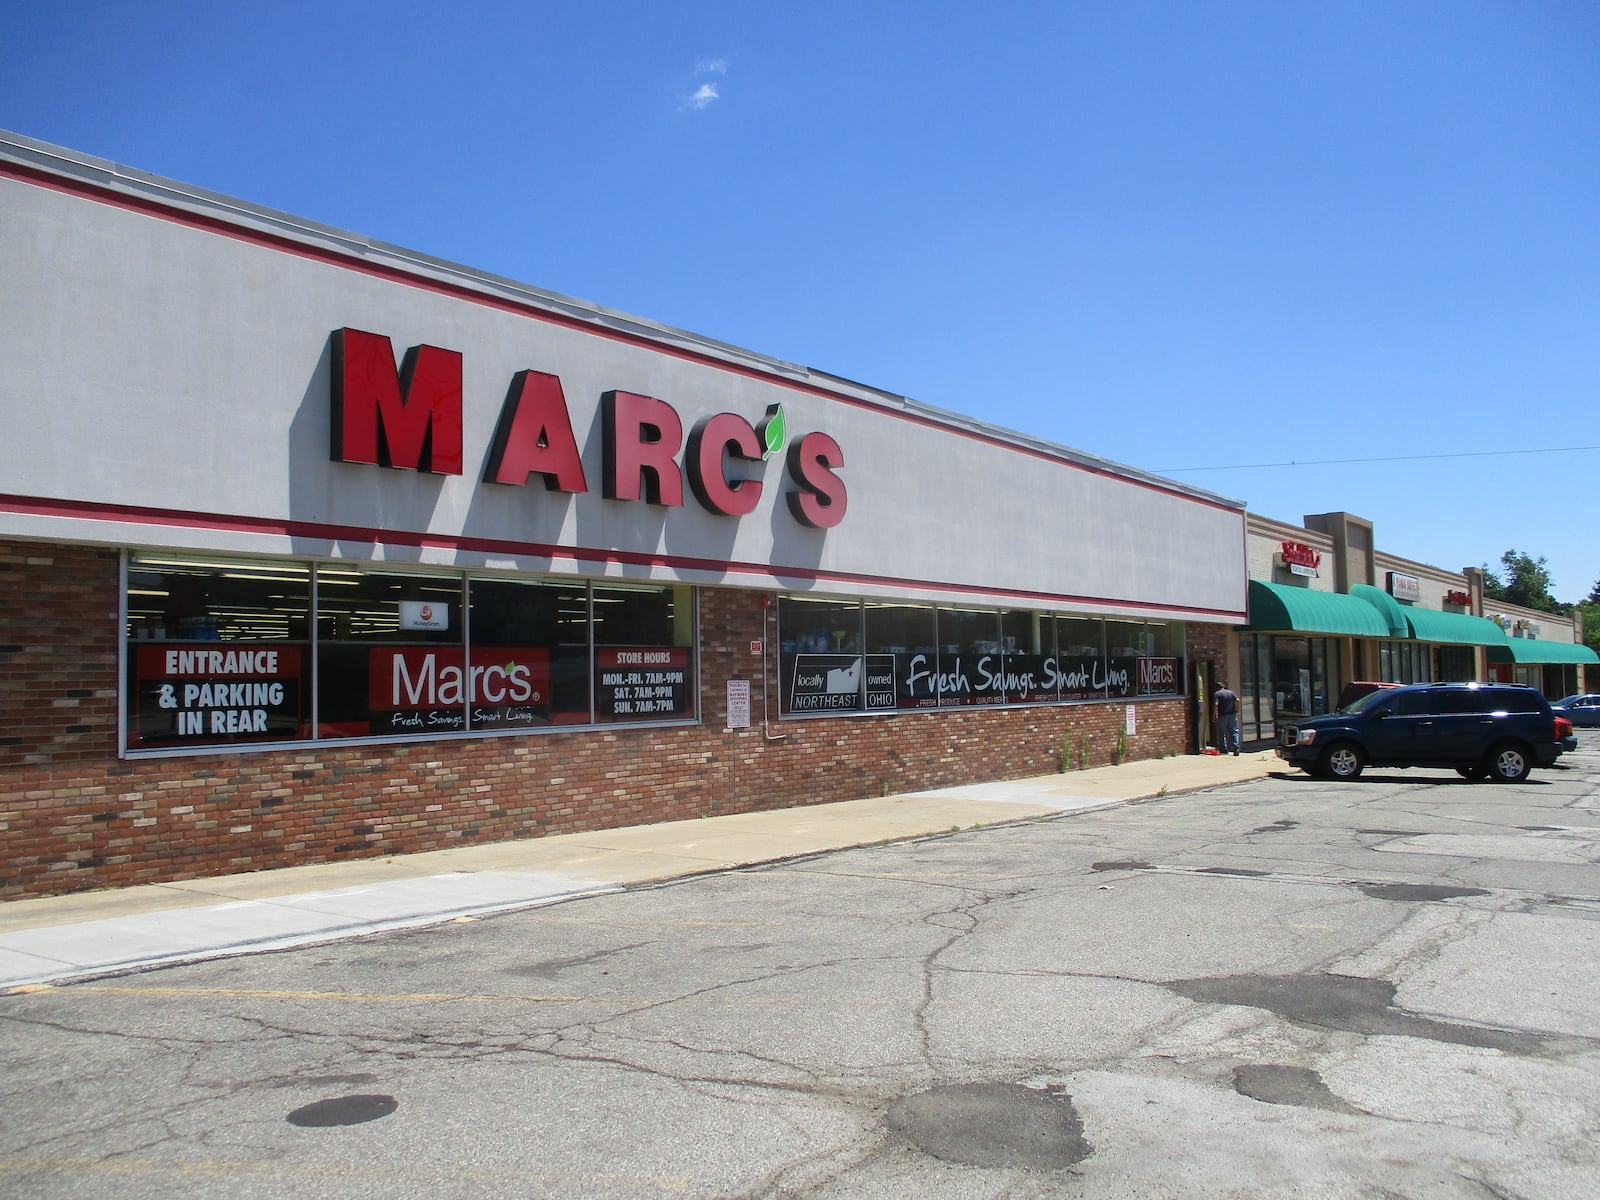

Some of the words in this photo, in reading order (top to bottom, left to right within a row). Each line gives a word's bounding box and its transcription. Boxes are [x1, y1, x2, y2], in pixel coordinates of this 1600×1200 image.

[331, 326, 848, 529] MARC'S
[165, 650, 278, 675] ENTRANCE
[616, 651, 643, 664] STORE
[643, 651, 671, 664] HOURS
[392, 653, 532, 706] Marc's
[602, 672, 644, 686] MON.-FRI.
[645, 671, 683, 684] 7AM-9PM
[798, 673, 825, 688] locally
[868, 673, 892, 685] owned
[905, 654, 971, 697] Fresh
[1041, 657, 1090, 691] Smart
[158, 684, 178, 709] &
[184, 682, 284, 708] PARKING
[614, 687, 633, 699] SAT.
[634, 686, 673, 699] 7AM-9PM
[795, 694, 858, 709] NORTHEAST
[869, 692, 893, 706] OHIO
[994, 695, 1009, 704] MEAS
[614, 701, 634, 714] SUN.
[635, 699, 674, 713] 7AM-7PM
[919, 698, 937, 707] FRESH
[939, 697, 960, 706] RODUCE
[178, 710, 202, 735] IN
[211, 709, 268, 734] REAR
[391, 711, 425, 728] Fresh
[472, 708, 502, 722] Smart
